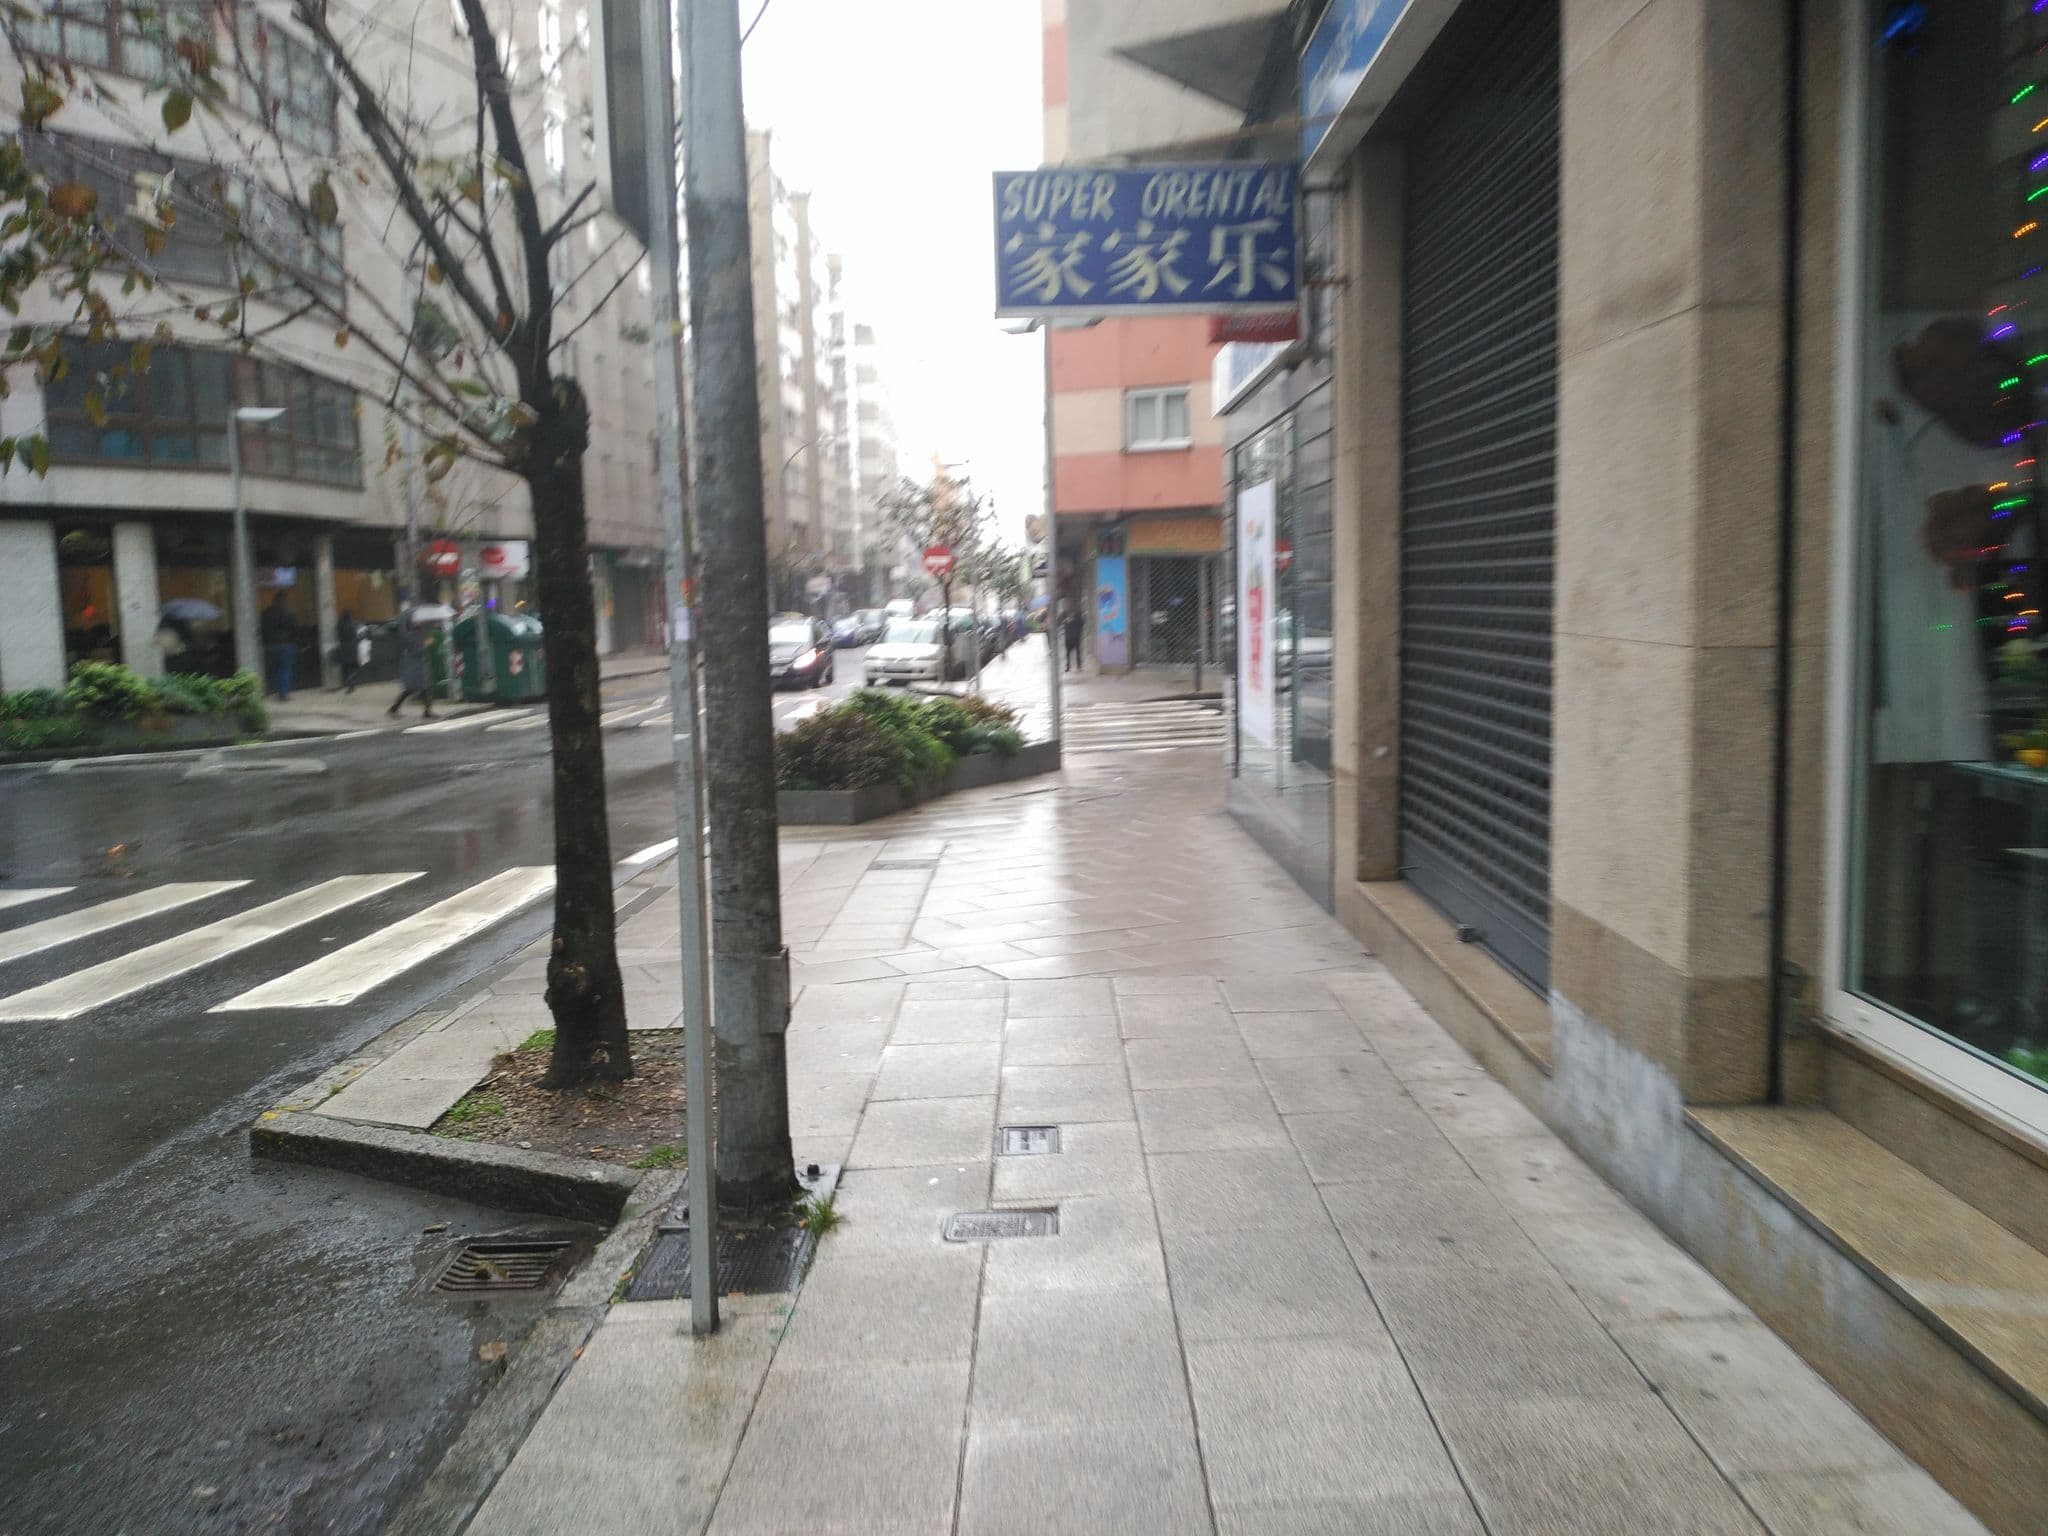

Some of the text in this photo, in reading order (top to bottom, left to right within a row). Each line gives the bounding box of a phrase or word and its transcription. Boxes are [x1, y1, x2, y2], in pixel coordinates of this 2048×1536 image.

[1002, 173, 1117, 219] SUPER
[1005, 221, 1290, 303] 家家乐
